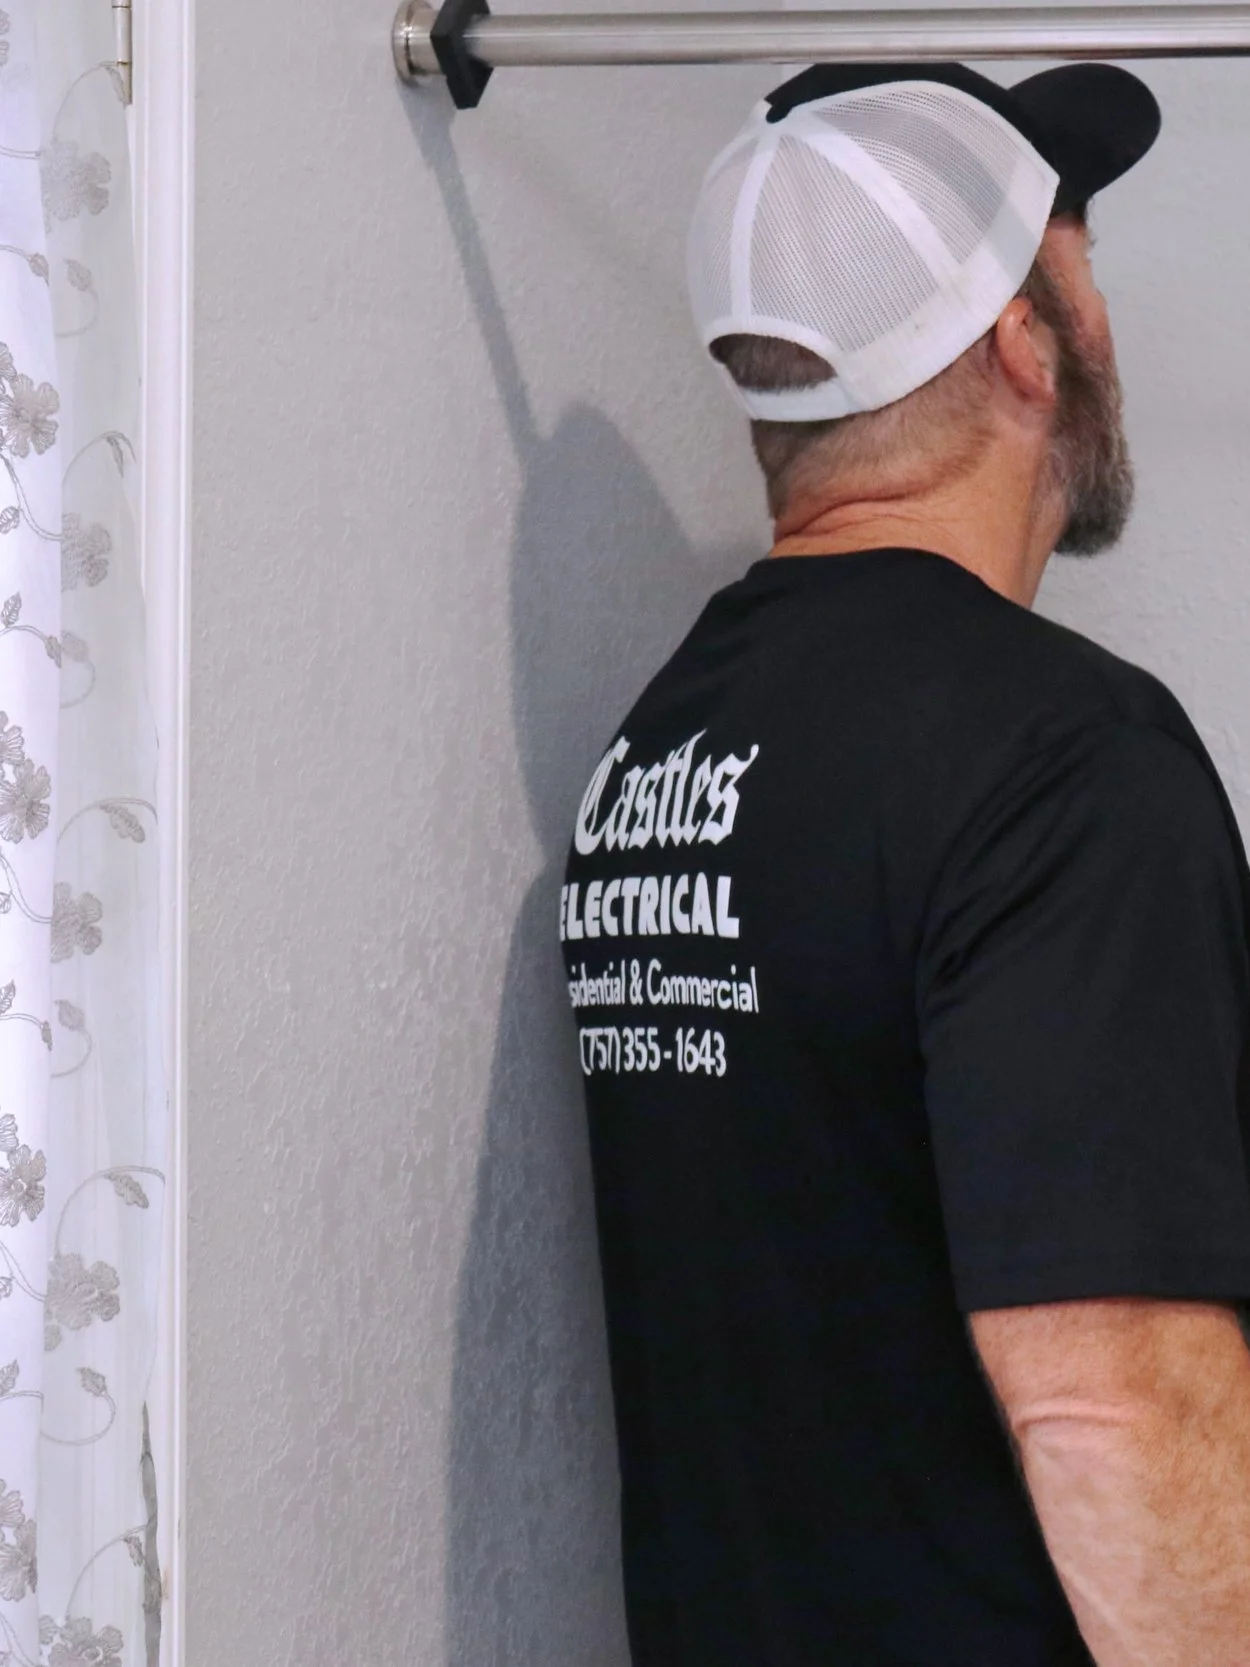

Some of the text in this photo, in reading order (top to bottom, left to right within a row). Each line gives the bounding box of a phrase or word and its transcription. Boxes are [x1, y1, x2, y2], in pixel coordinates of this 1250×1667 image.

[574, 728, 760, 855] Castles
[629, 958, 644, 1005] &
[646, 958, 760, 1014] Commercial
